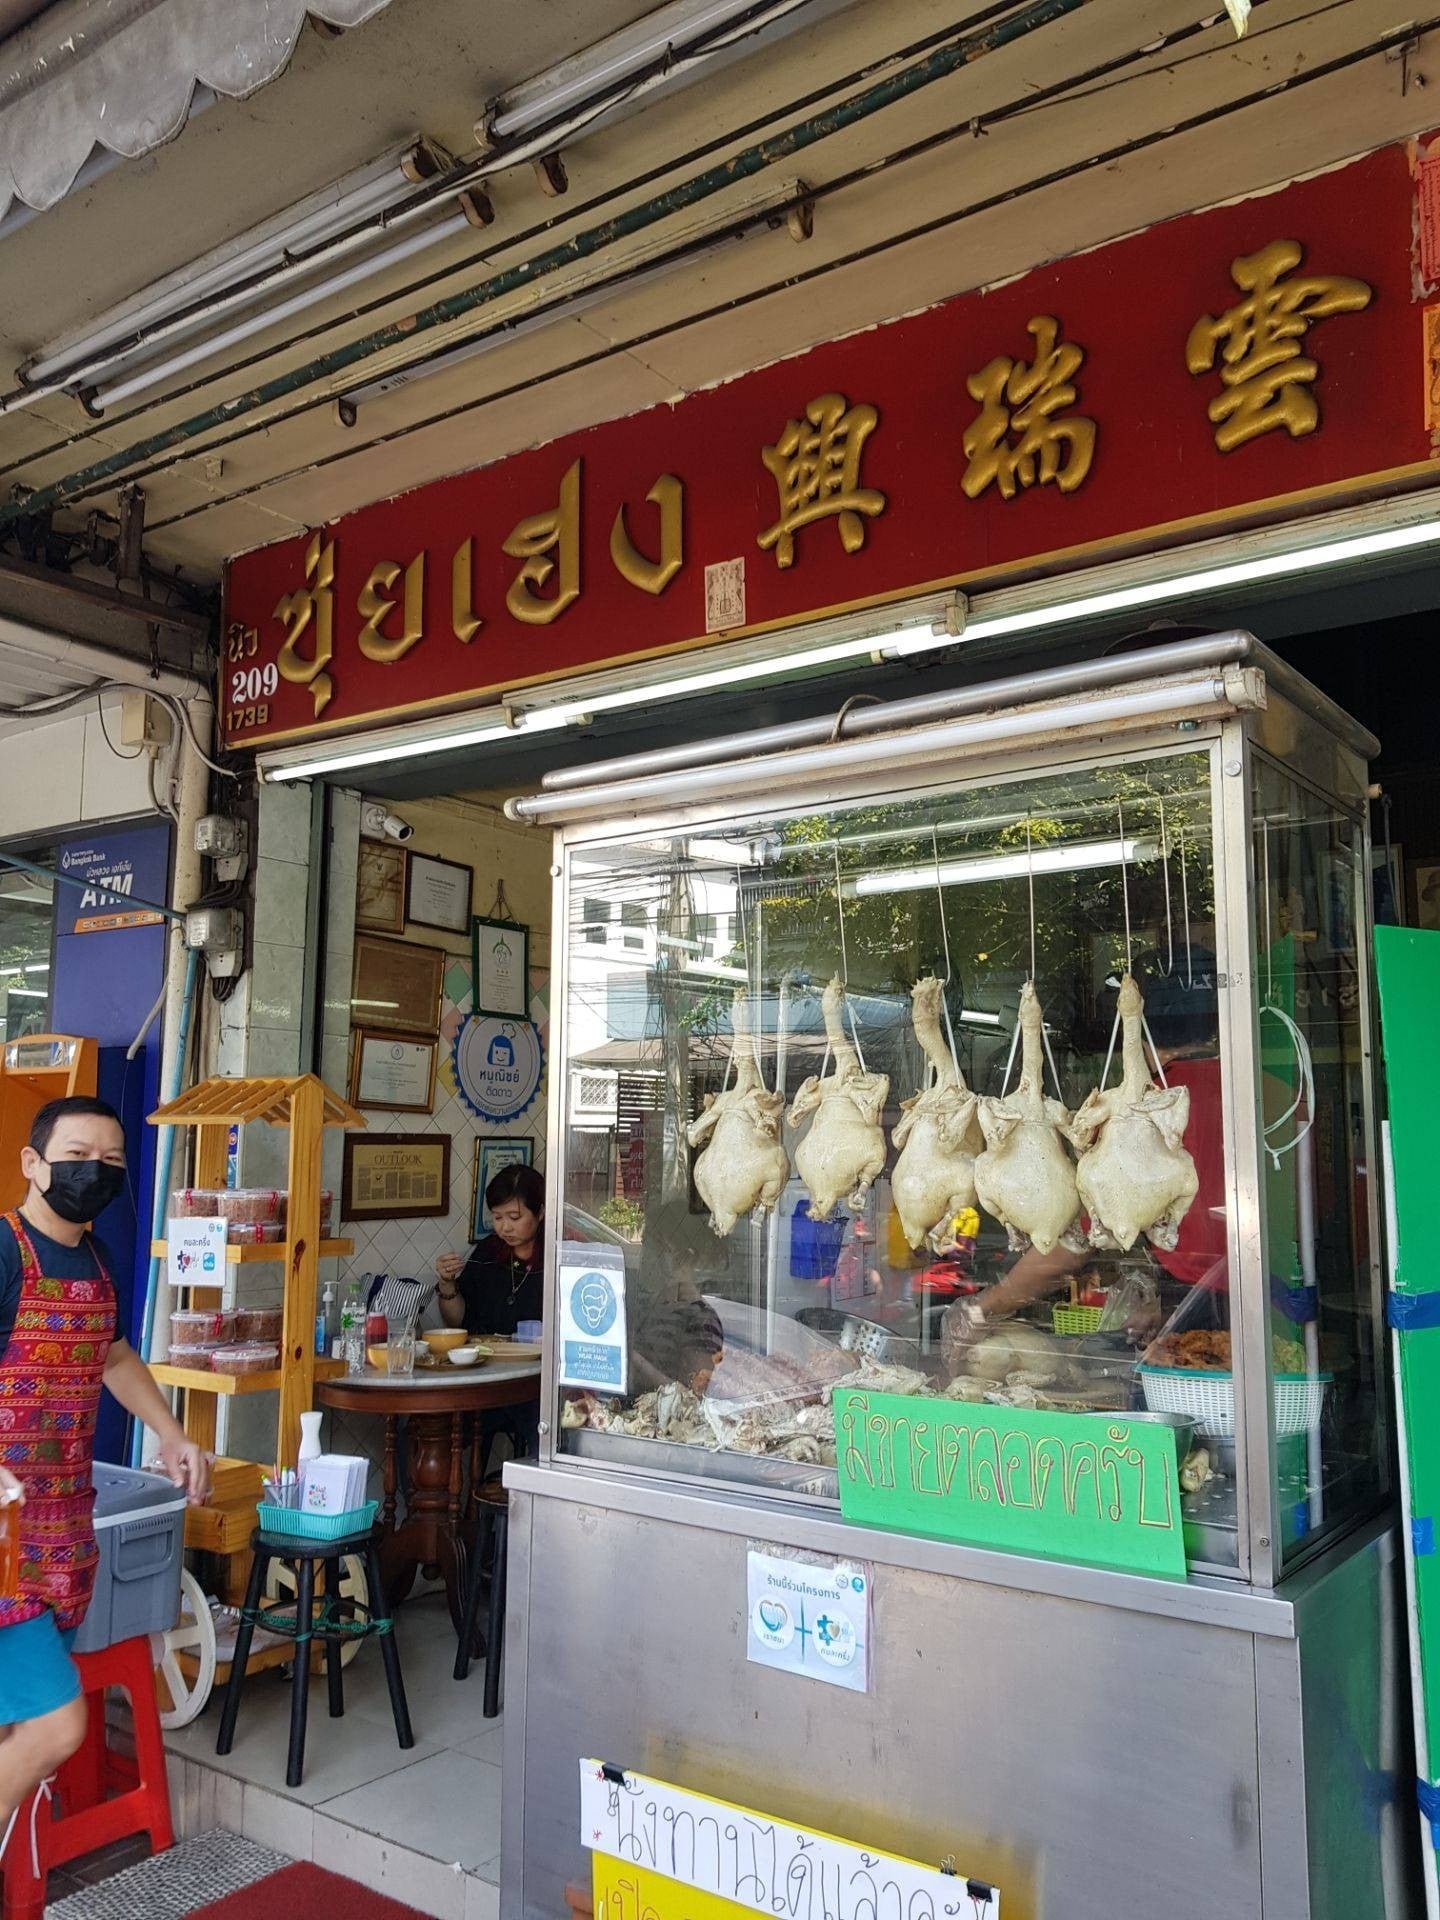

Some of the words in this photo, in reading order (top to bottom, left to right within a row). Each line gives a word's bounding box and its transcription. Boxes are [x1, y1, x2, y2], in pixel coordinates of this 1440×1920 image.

[232, 662, 279, 704] 209
[71, 855, 92, 866] Bangkok
[93, 853, 106, 862] Bank
[80, 873, 134, 908] ATM
[374, 1154, 424, 1166] OUTLOOK
